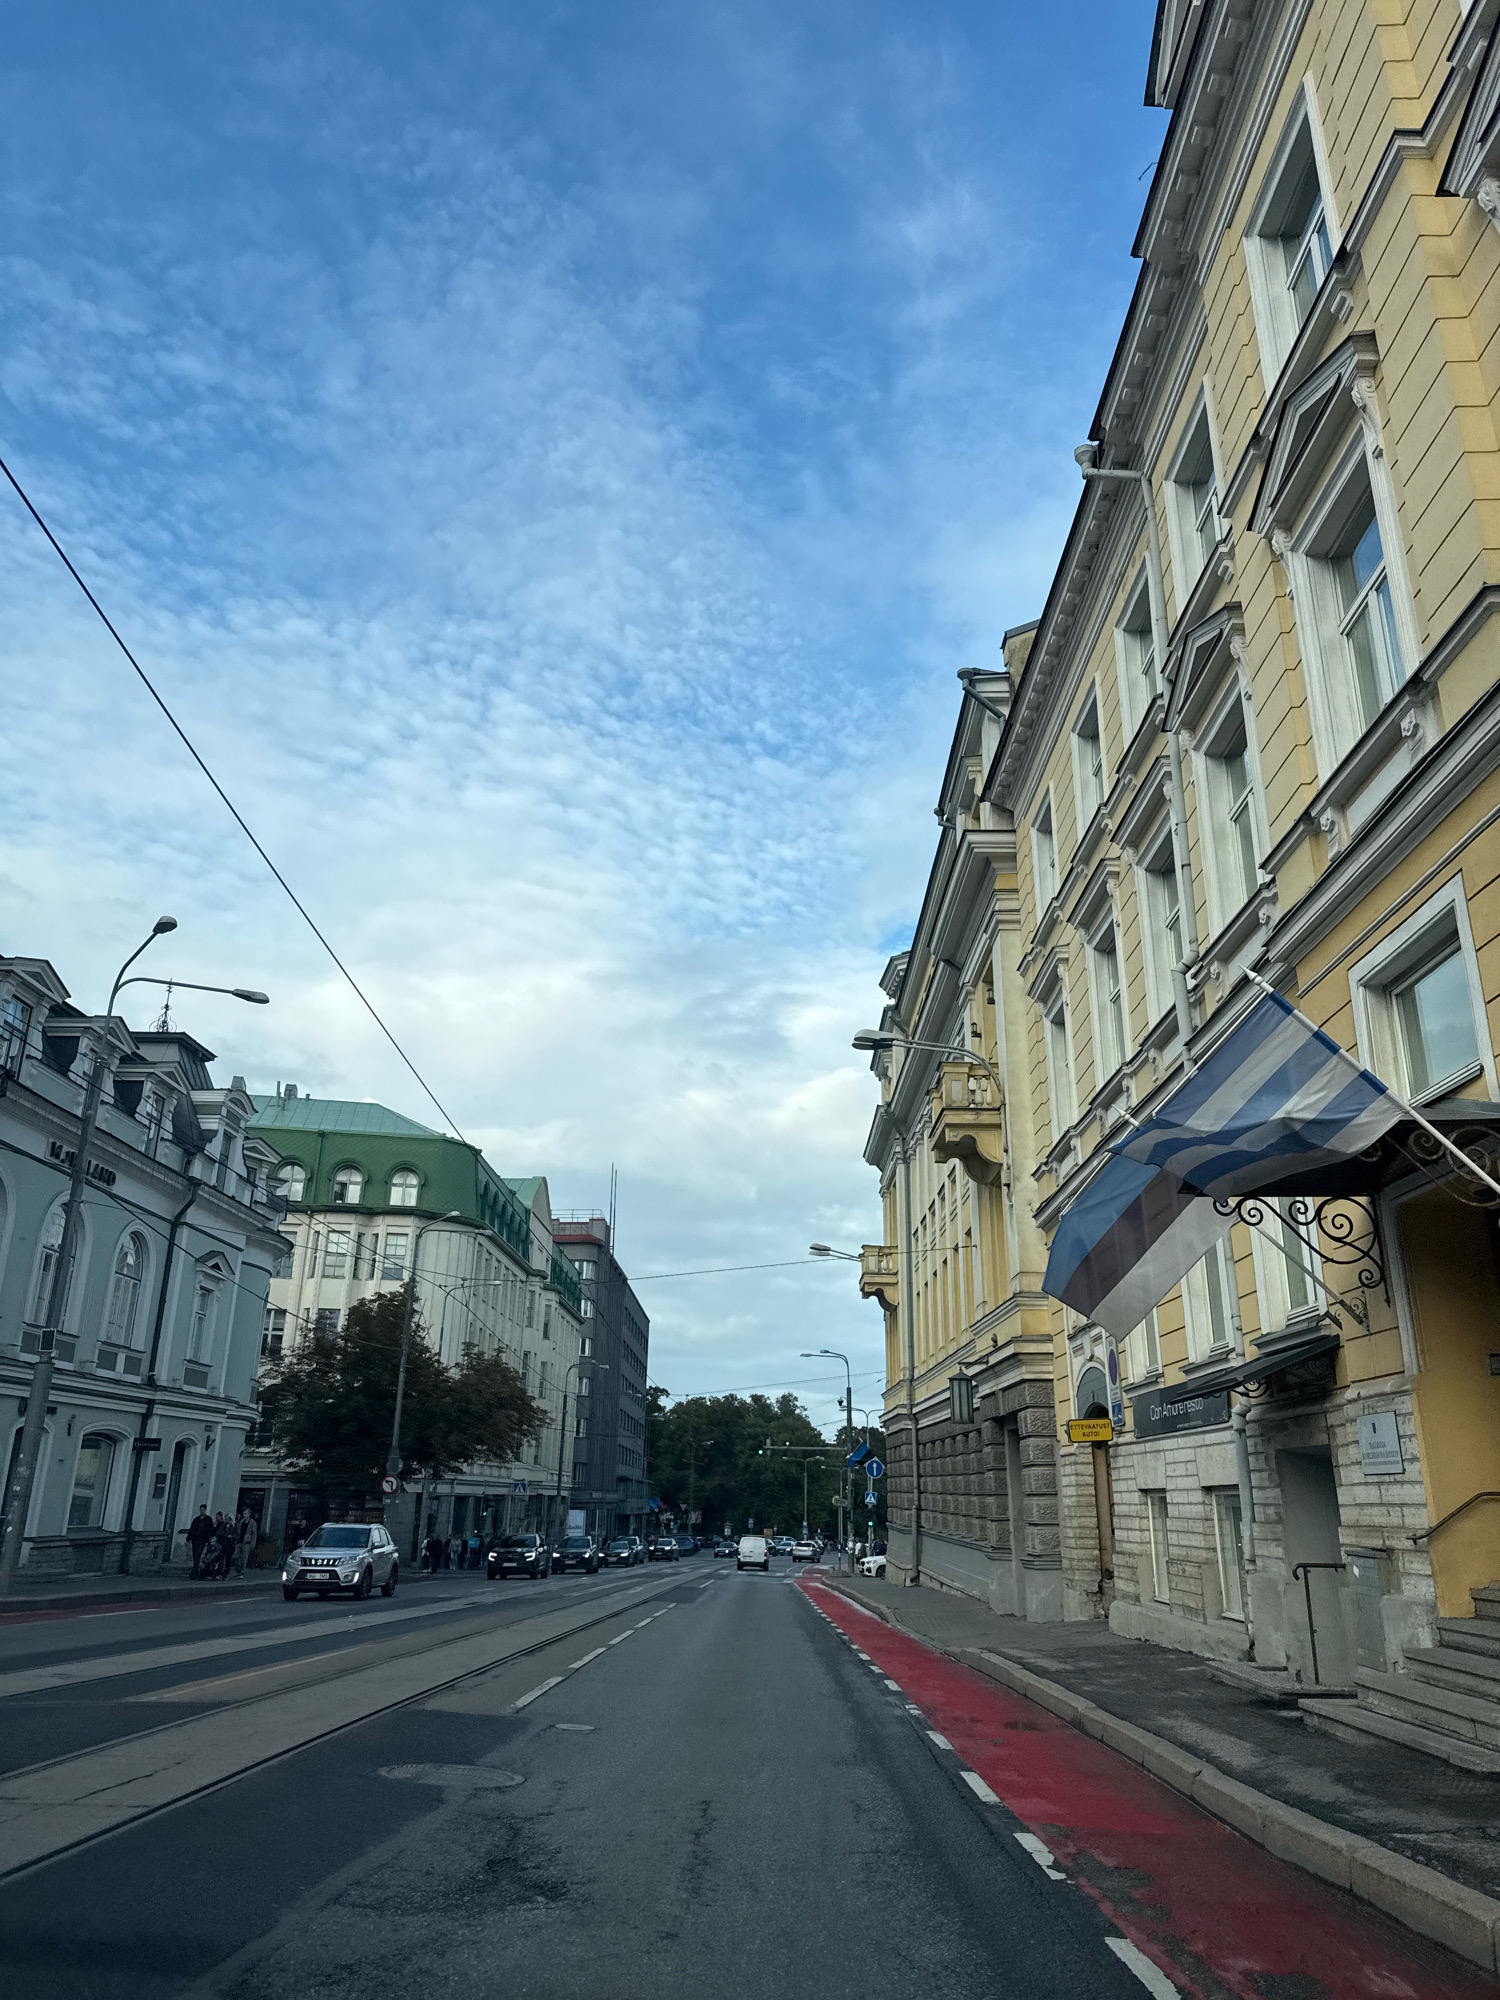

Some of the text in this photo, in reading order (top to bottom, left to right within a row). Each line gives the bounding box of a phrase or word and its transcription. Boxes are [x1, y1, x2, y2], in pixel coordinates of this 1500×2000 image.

[1150, 1397, 1204, 1421] Con Amore resto
[1070, 1423, 1110, 1431] ETTEVAATUST
